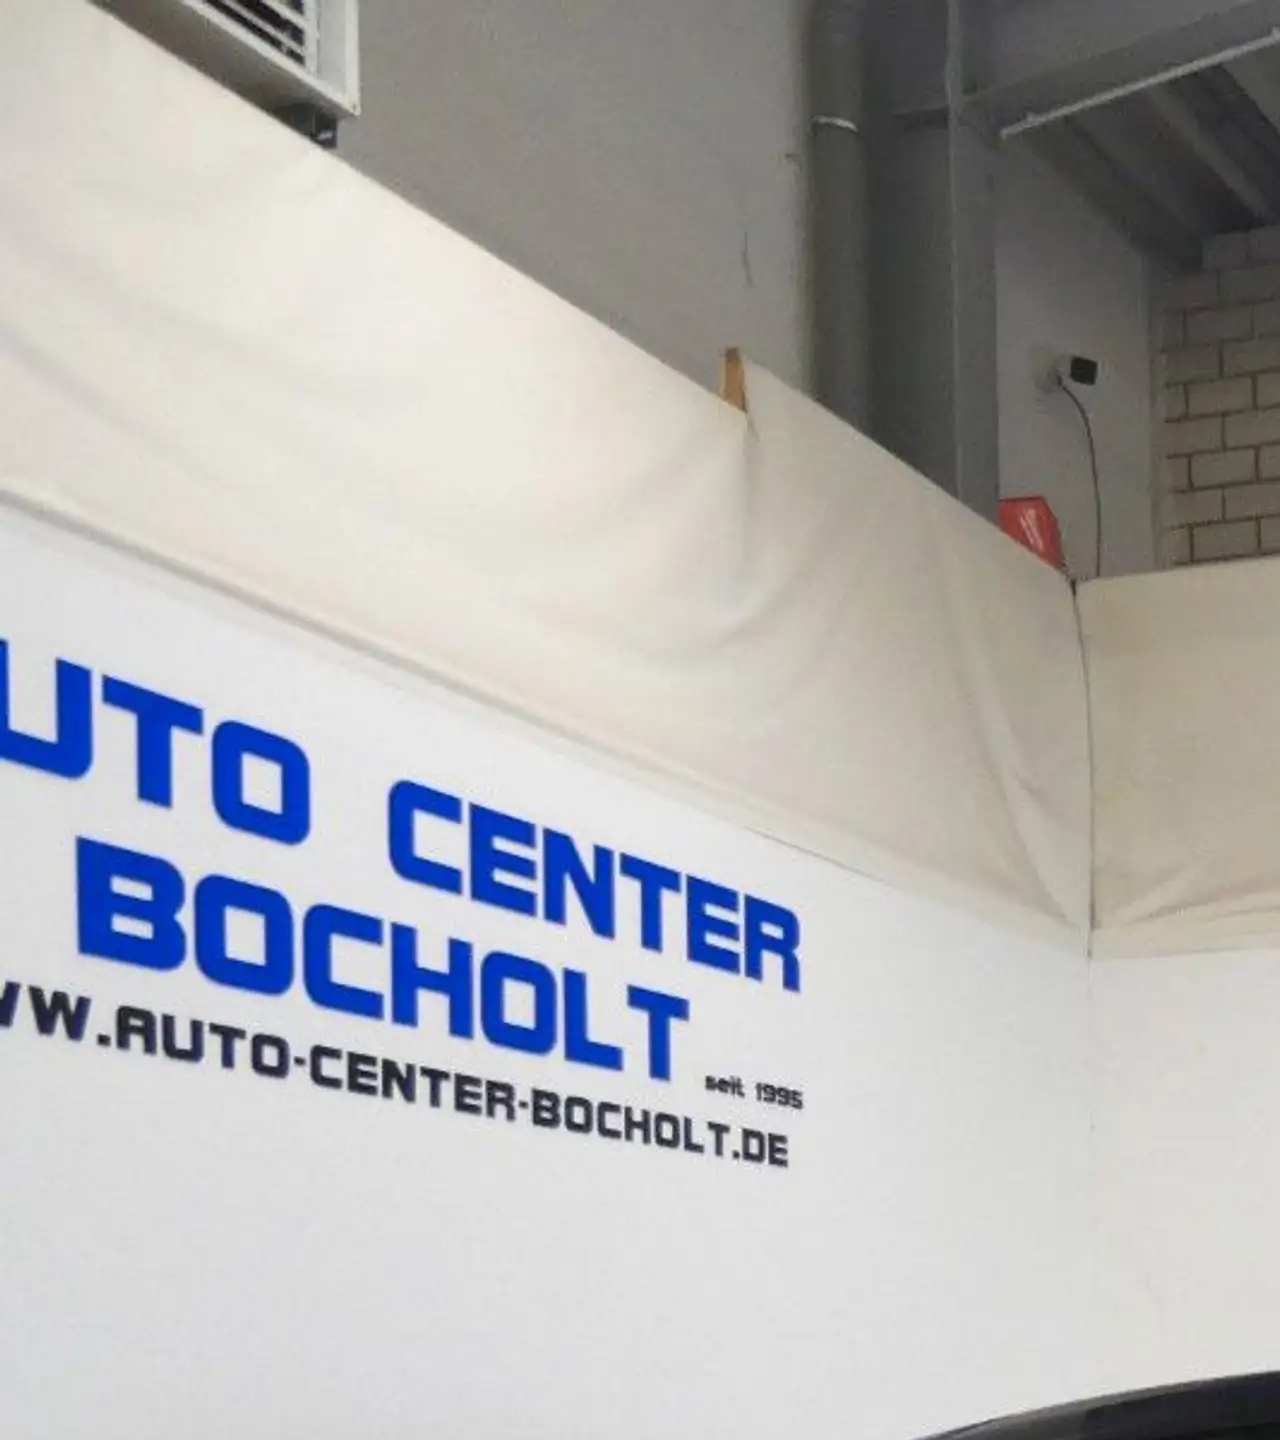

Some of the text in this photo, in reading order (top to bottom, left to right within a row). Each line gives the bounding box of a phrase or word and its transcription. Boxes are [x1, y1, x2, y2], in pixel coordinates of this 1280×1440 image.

[76, 836, 803, 1110] BOCHOLT seit 1995
[387, 779, 801, 992] CENTER
